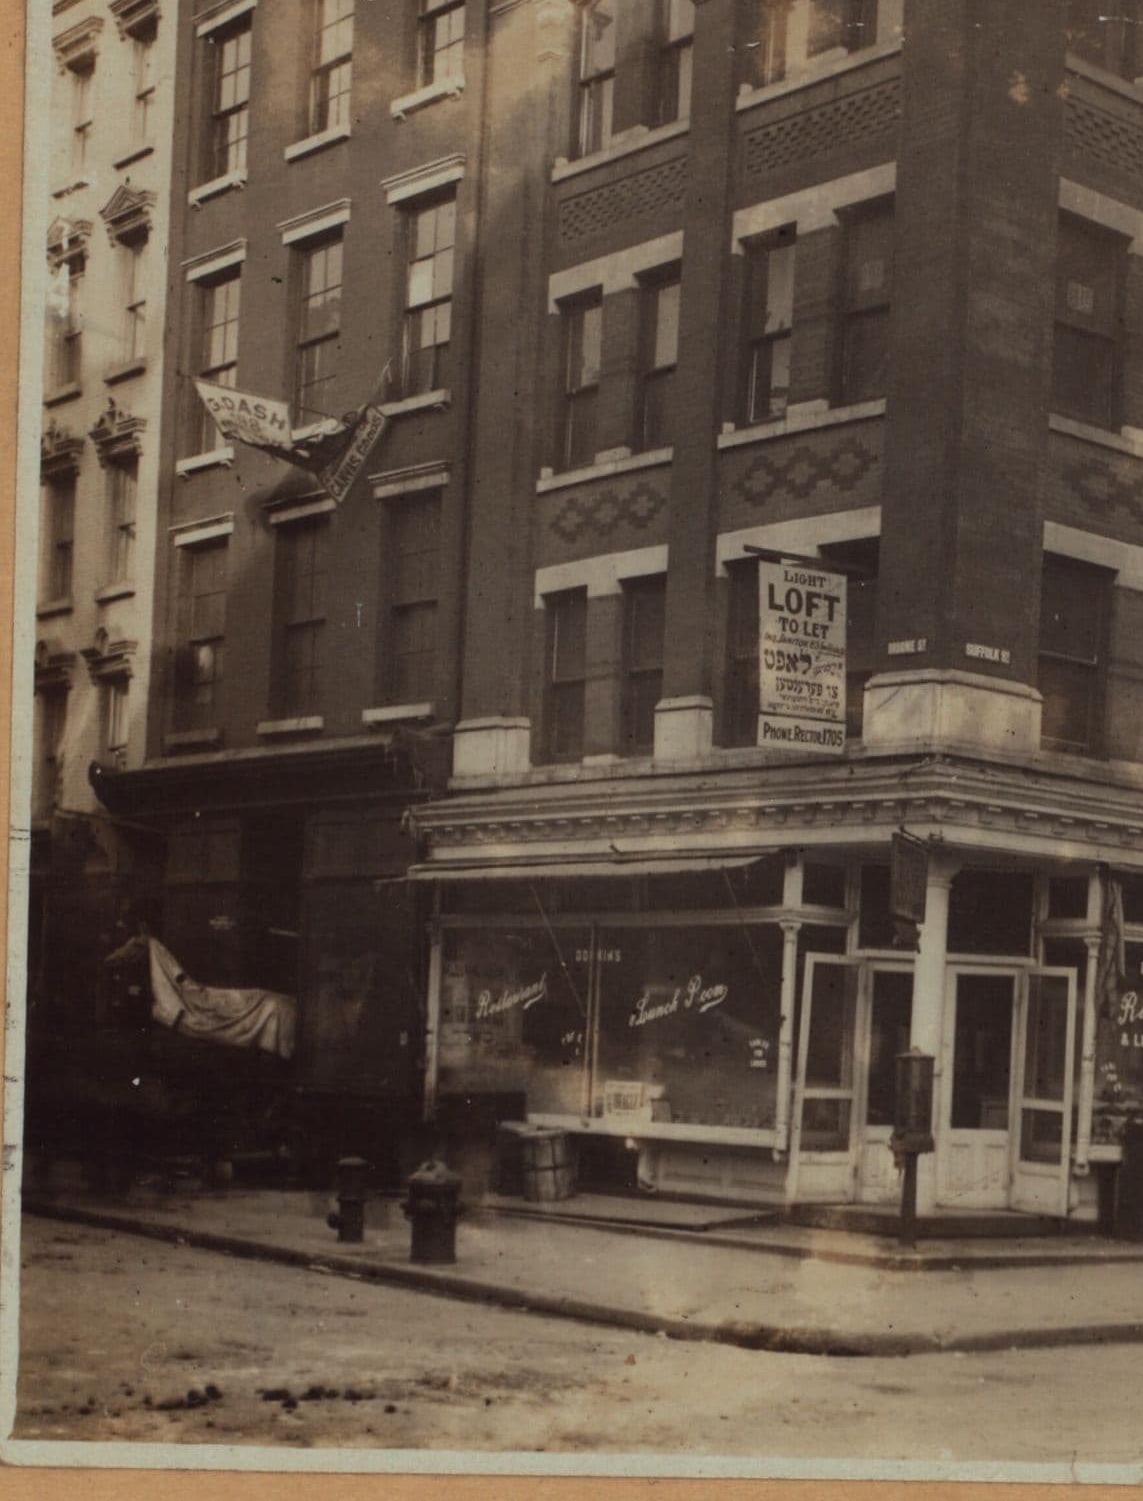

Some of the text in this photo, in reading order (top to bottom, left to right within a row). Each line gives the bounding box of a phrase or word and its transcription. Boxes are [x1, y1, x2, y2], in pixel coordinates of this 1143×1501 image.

[784, 569, 826, 589] LIGHT
[768, 582, 841, 622] LOFT
[779, 616, 829, 640] TO LET
[628, 975, 729, 1027] Lunch Room
